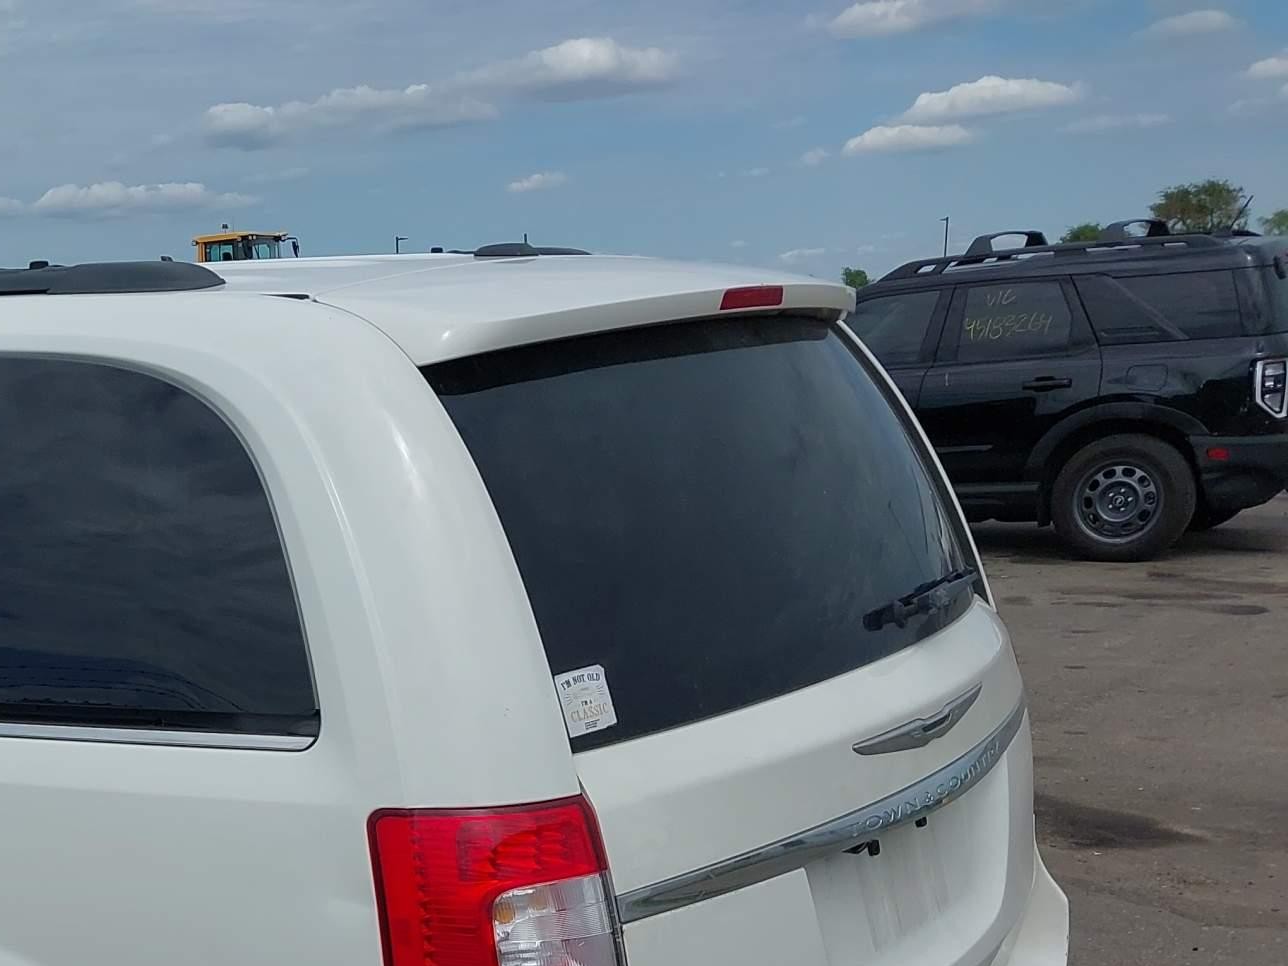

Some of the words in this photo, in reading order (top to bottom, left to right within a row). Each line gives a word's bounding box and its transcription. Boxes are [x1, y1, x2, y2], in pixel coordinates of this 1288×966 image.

[572, 673, 585, 685] NOT
[586, 672, 601, 682] OLD
[570, 702, 609, 722] CLASSIC
[852, 797, 921, 837] TOWN
[924, 790, 935, 804] &
[936, 740, 1001, 797] COUNTRY
